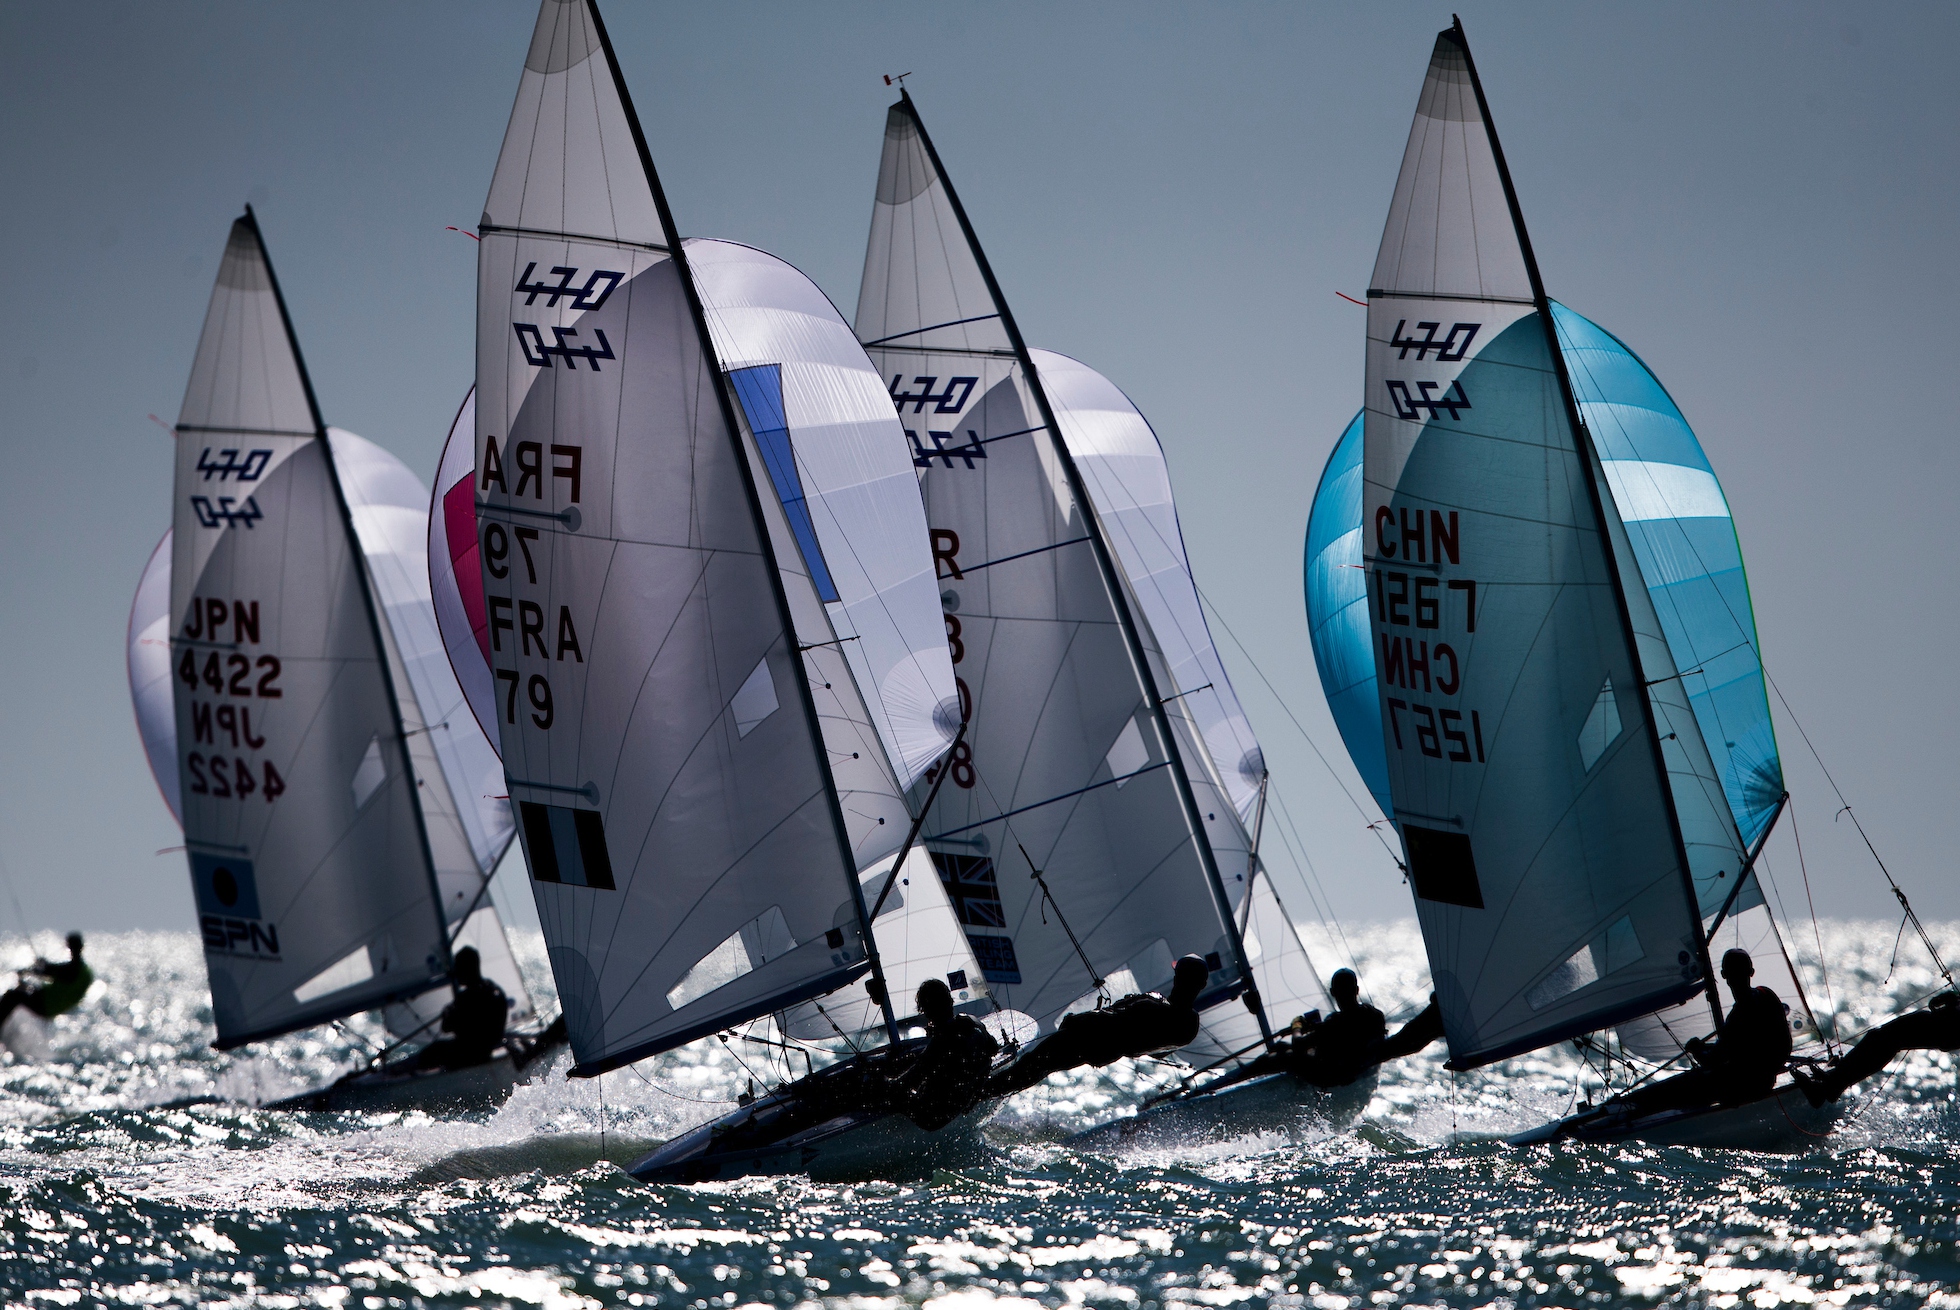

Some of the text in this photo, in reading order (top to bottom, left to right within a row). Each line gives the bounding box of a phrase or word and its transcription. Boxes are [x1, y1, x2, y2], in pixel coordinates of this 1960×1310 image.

[514, 262, 626, 311] 470
[1390, 319, 1482, 362] 470
[197, 447, 273, 483] 470
[1375, 505, 1460, 565] CHN
[185, 597, 260, 644] JPN
[488, 594, 584, 663] FRA
[179, 648, 282, 699] 4422
[496, 668, 554, 730] 79
[202, 916, 278, 953] SPN
[970, 938, 1010, 948] RITISH
